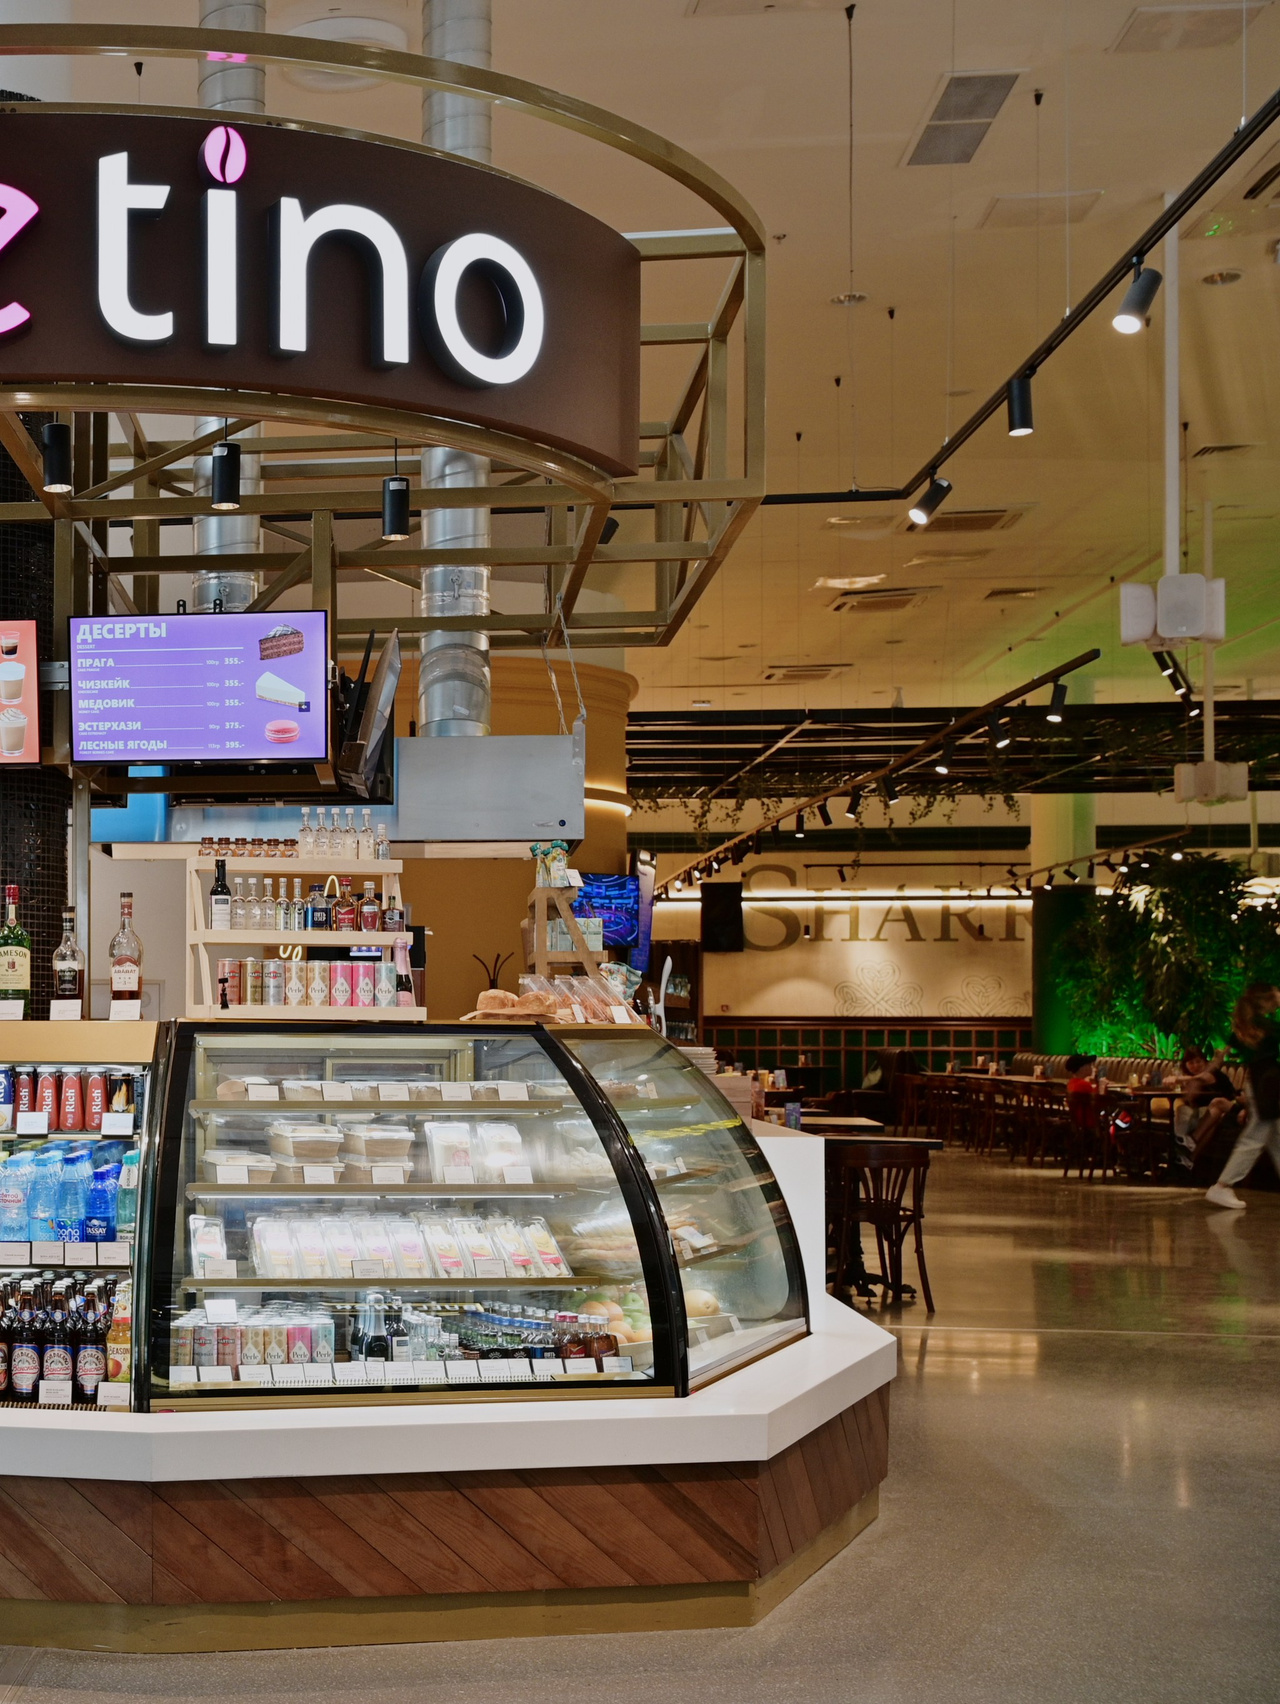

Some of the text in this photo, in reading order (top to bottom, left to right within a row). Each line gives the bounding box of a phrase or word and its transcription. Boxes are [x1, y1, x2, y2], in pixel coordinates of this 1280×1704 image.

[99, 126, 544, 385] tino
[77, 622, 166, 643] ДЕСЕРТЫ
[77, 658, 115, 668] ПРАГА
[78, 677, 130, 689] ЧИЗКЕЙК
[78, 699, 135, 710] МЕДОВИК
[78, 721, 141, 731] ЭСТЕРХАЗИ
[78, 741, 125, 750] ЛЕСНЫЕ
[127, 740, 167, 751] ЯГОДЫ
[20, 1088, 28, 1111] Rich
[43, 1089, 52, 1112] Rich
[66, 1089, 75, 1112] Rich
[92, 1089, 101, 1112] Rich
